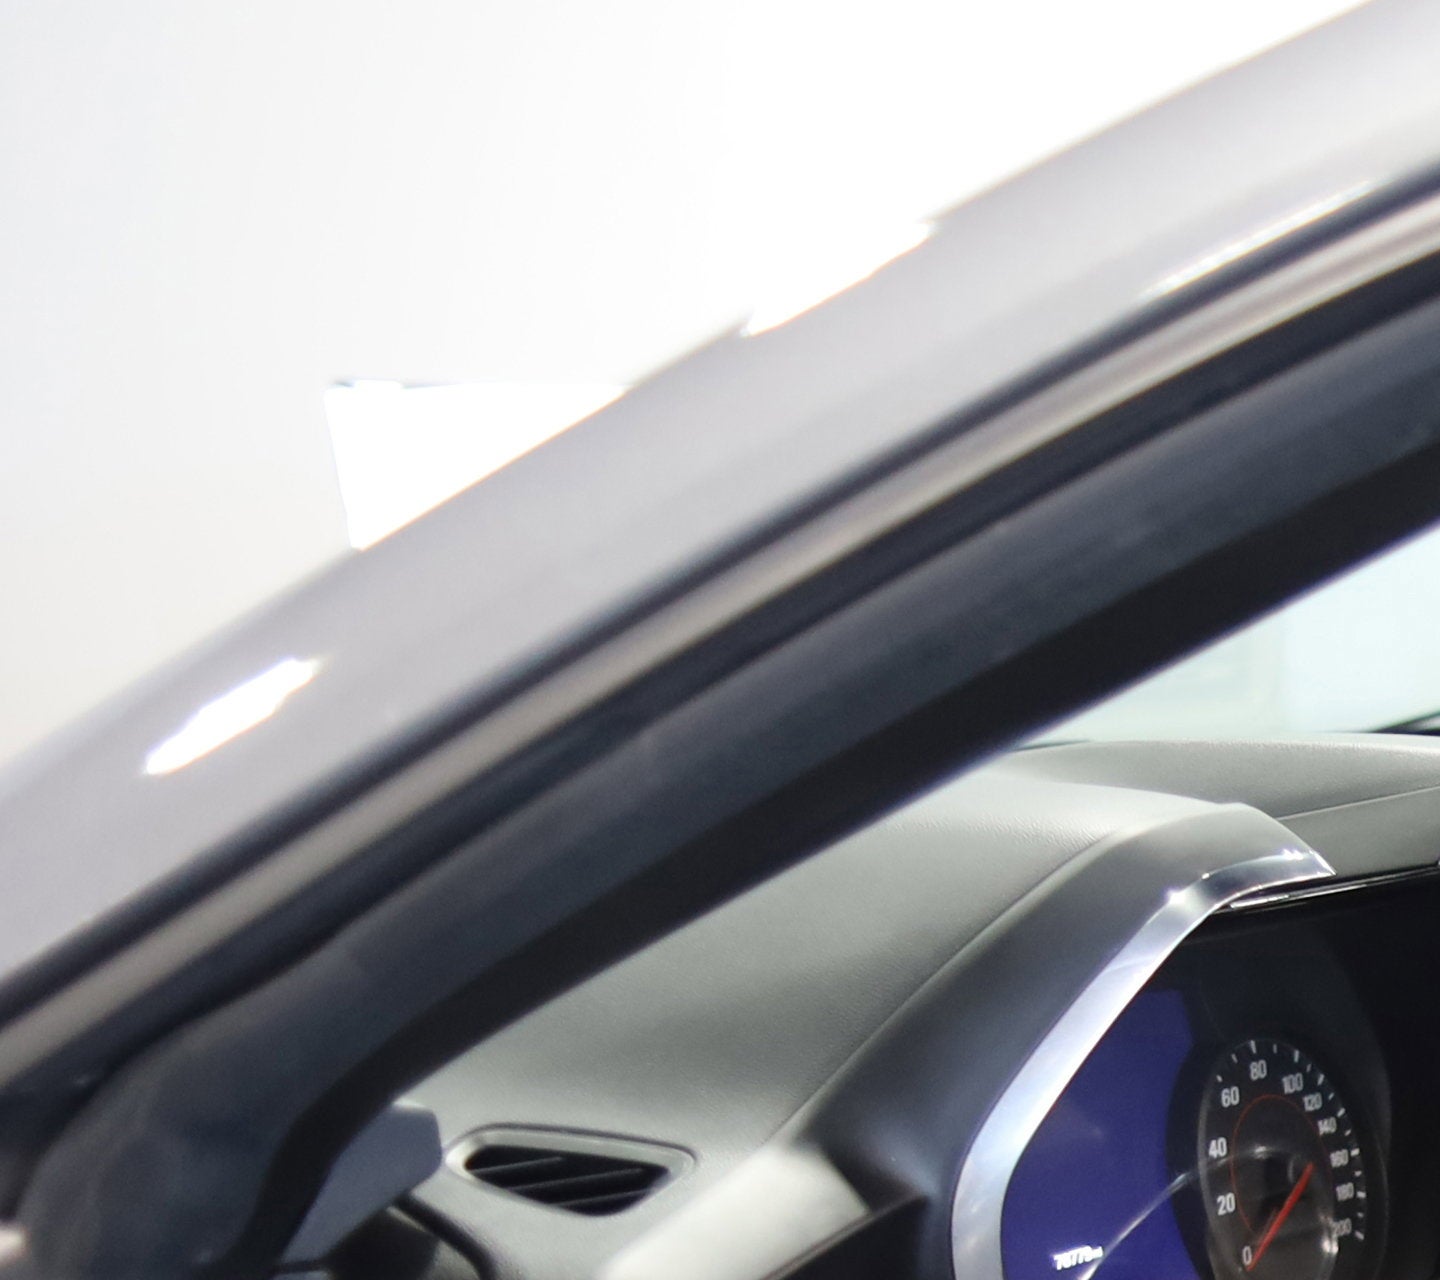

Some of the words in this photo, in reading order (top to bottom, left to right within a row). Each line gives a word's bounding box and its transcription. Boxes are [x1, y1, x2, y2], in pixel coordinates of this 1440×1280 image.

[1250, 1060, 1267, 1081] 80
[1282, 1073, 1303, 1094] 100
[1221, 1086, 1239, 1108] 60
[1303, 1093, 1322, 1112] 120
[1318, 1117, 1337, 1136] 140
[1208, 1137, 1227, 1159] 40
[1217, 1193, 1236, 1216] 20
[1242, 1246, 1252, 1266] 0
